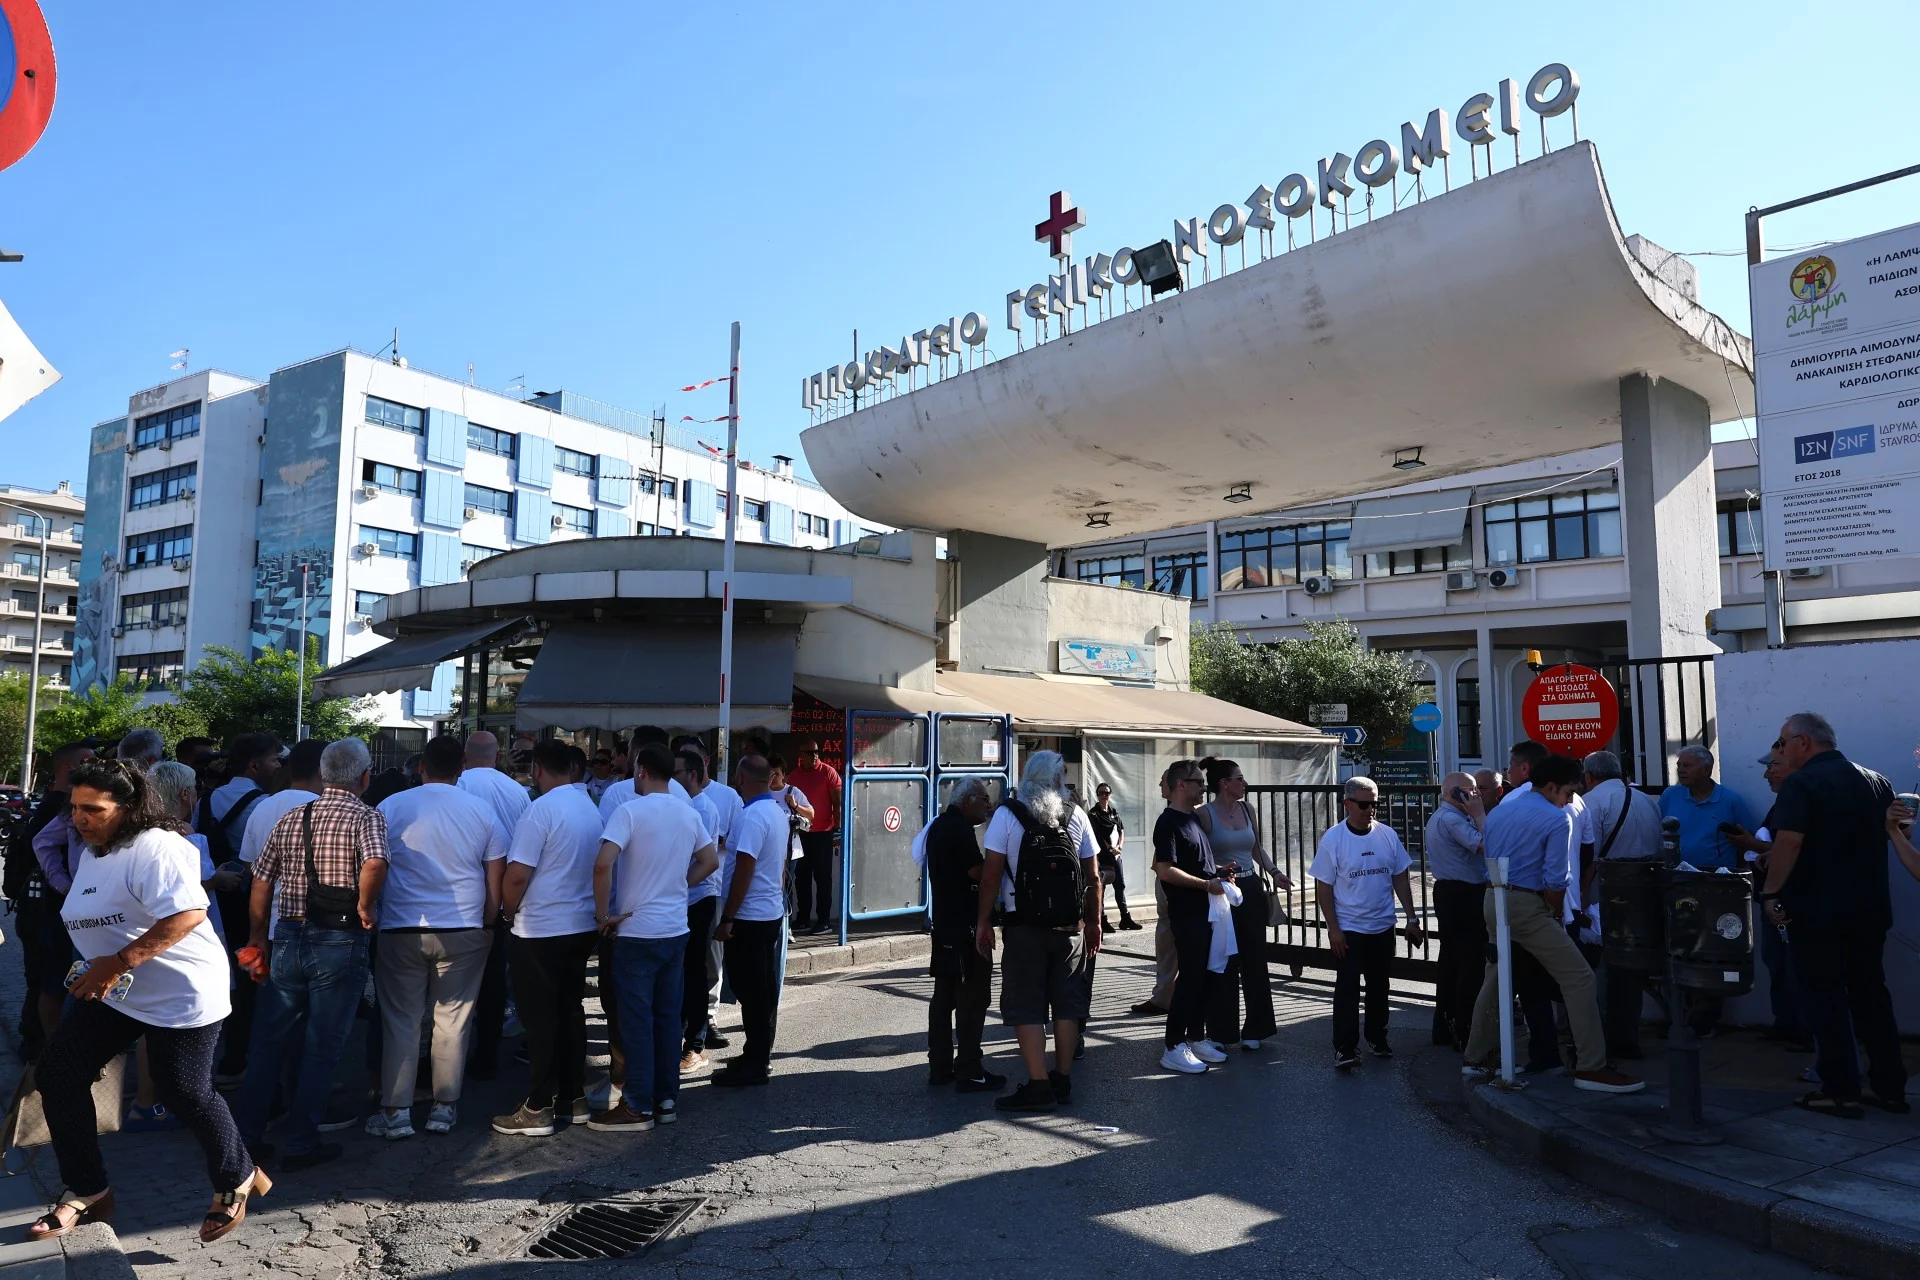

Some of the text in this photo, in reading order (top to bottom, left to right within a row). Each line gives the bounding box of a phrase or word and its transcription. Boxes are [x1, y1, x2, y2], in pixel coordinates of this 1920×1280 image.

[802, 62, 1580, 409] ΙΠΠΟΚΡΑΤΕΙΟ ΓΕΝΙΚΟ ΝΟΣΟΚΟΜΕΙΟ
[1866, 256, 1881, 267] «Η
[1869, 266, 1917, 284] ΠΑΙΔΙΩΝ
[1790, 347, 1857, 368] ΔΗΜΙΟΥΡΓΙΑ
[1796, 361, 1862, 381] ΑΝΑΚΑΙΝΙΣΗ
[1879, 420, 1918, 434] ΙΔΡΥΜΑ
[1801, 441, 1827, 457] ΙΣΝ
[1837, 433, 1869, 451] SNF
[1794, 469, 1841, 482] ΕΤΟΣ 2018
[1539, 673, 1597, 685] ΑΠΑΓΟΡΕΥΕΤΑΙ
[1555, 683, 1589, 692] ΕΙΣΟΔΟΣ
[1542, 691, 1596, 702] ΣΤΑ ΟΧΗΜΑΤΑ
[1539, 721, 1602, 732] ΠΟΥ ΔΕΝ ΕΧΟΥΝ
[1545, 730, 1597, 740] ΕΙΔΙΚΟ ΣΗΜΑ
[79, 912, 126, 930] ΦΟΒΟΜΑΣΤΕ
